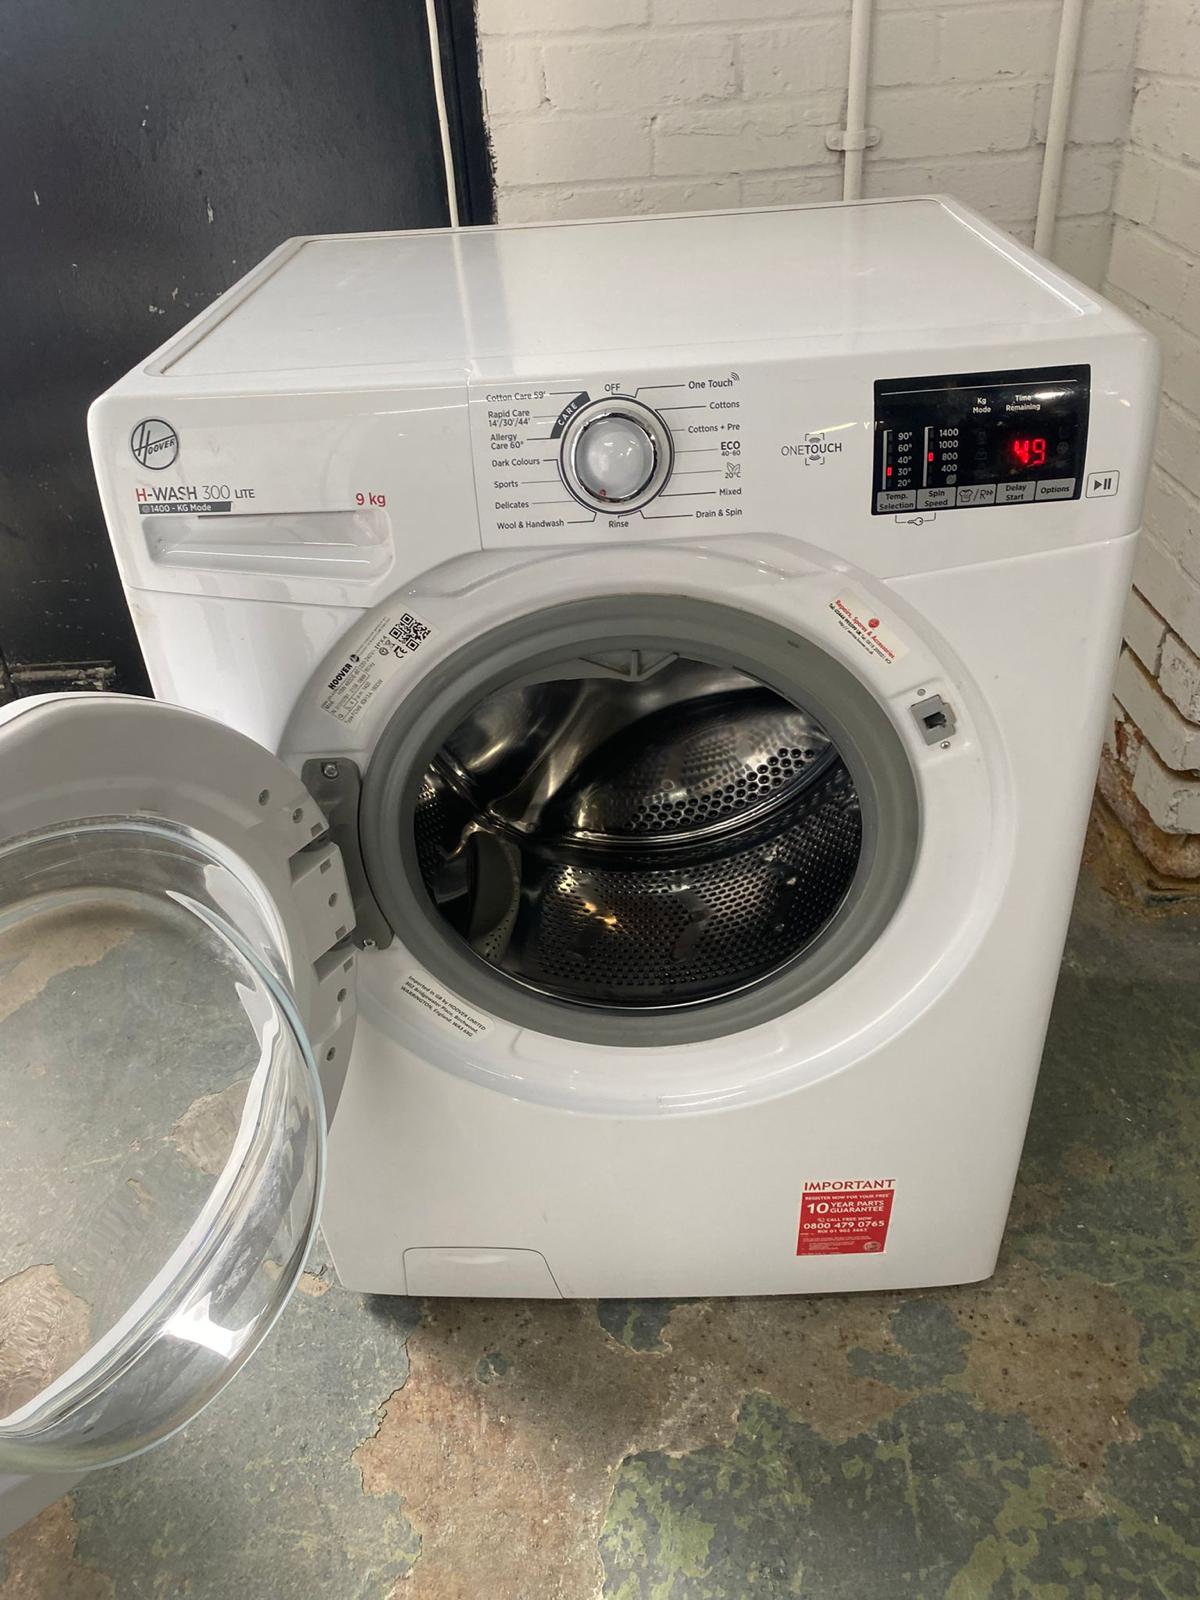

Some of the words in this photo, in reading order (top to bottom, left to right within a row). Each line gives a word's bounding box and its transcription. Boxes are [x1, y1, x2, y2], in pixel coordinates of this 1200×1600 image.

[604, 383, 621, 393] OFF
[688, 380, 707, 389] One
[708, 378, 733, 389] Touch
[486, 394, 512, 402] Cotton
[514, 392, 532, 401] Care
[977, 397, 987, 407] Kg
[1015, 394, 1032, 403] Time
[709, 400, 740, 409] Cottons
[972, 405, 992, 414] Mode
[1005, 403, 1041, 412] Remaining
[488, 410, 510, 420] Rapid
[512, 409, 530, 417] Care
[557, 402, 578, 425] CARE
[687, 424, 718, 433] Cottons
[727, 423, 741, 431] Pre
[939, 428, 959, 437] 1400
[490, 433, 517, 442] Allergy
[490, 442, 509, 450] Care
[720, 441, 741, 450] ECO
[939, 440, 959, 449] 1000
[941, 452, 958, 461] 800
[1013, 438, 1046, 465] 49
[491, 458, 510, 467] Dark
[512, 456, 540, 467] Colours
[941, 464, 958, 472] 400
[494, 480, 519, 490] Sports
[1005, 484, 1028, 494] Delay
[1040, 484, 1071, 495] Options
[135, 486, 198, 502] H-WASH
[201, 484, 231, 500] 300
[234, 488, 256, 499] LITE
[719, 487, 742, 496] Mixed
[928, 490, 945, 499] Spin
[355, 492, 364, 505] 9
[368, 492, 386, 507] kg
[885, 493, 908, 501] Temp.
[1005, 493, 1025, 502] Start
[150, 504, 170, 512] 1400
[176, 504, 188, 512] KG
[190, 503, 212, 512] Mode
[495, 500, 529, 509] Delicates
[879, 502, 914, 511] Selection
[924, 499, 948, 508] Speed
[695, 509, 717, 519] Drain
[718, 509, 727, 517] &
[728, 507, 743, 517] Spin
[496, 520, 516, 530] Wool
[518, 520, 524, 528] &
[525, 518, 565, 528] Handwash
[608, 519, 630, 529] Rinse
[851, 616, 867, 632] Spares
[872, 635, 895, 659] Accessories
[327, 663, 353, 690] HOOVER
[448, 1003, 468, 1018] HOOVER
[804, 1179, 896, 1191] IMPORTANT
[807, 1202, 829, 1214] 10
[803, 1222, 831, 1230] 0800
